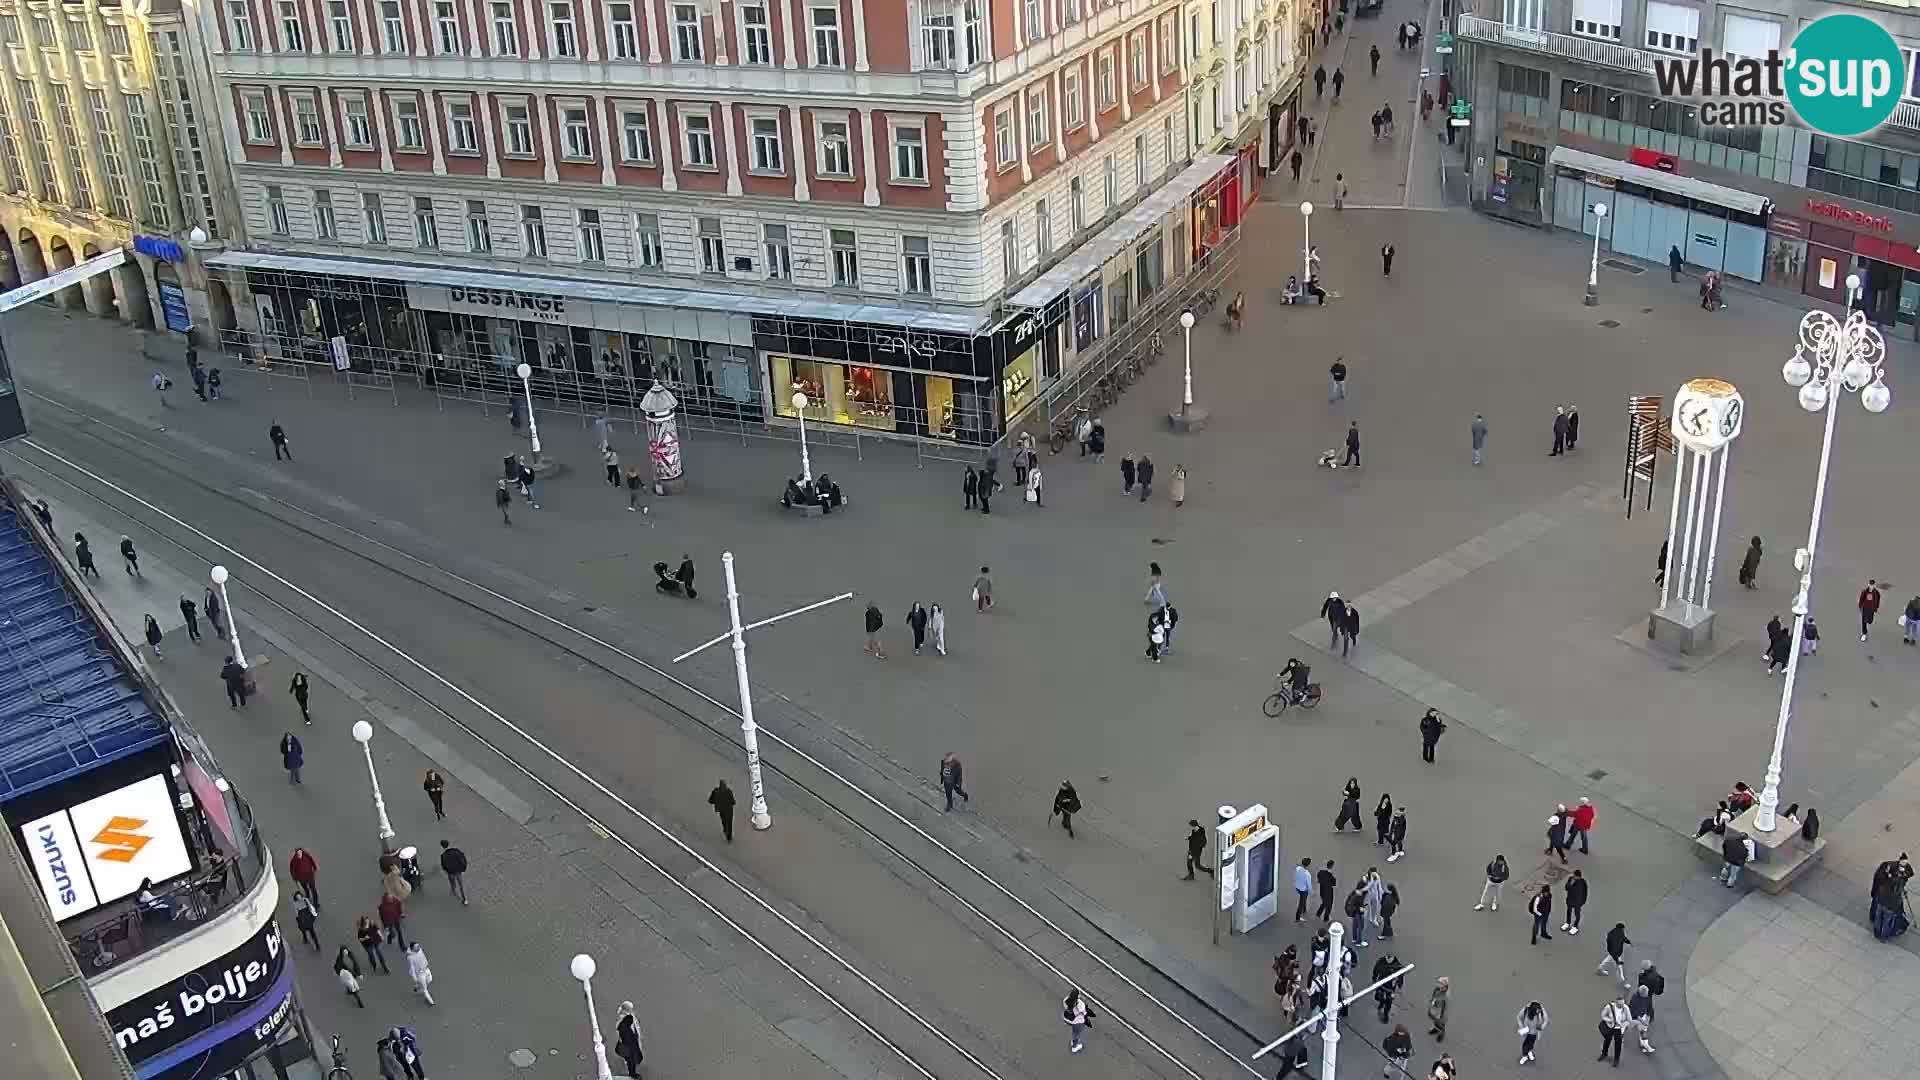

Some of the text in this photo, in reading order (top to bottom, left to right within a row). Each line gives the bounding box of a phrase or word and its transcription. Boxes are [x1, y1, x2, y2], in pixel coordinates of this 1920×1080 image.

[451, 287, 565, 313] DESSANGE
[38, 824, 77, 906] SUZUKI
[115, 1001, 175, 1049] naš
[179, 960, 268, 1017] bolje,
